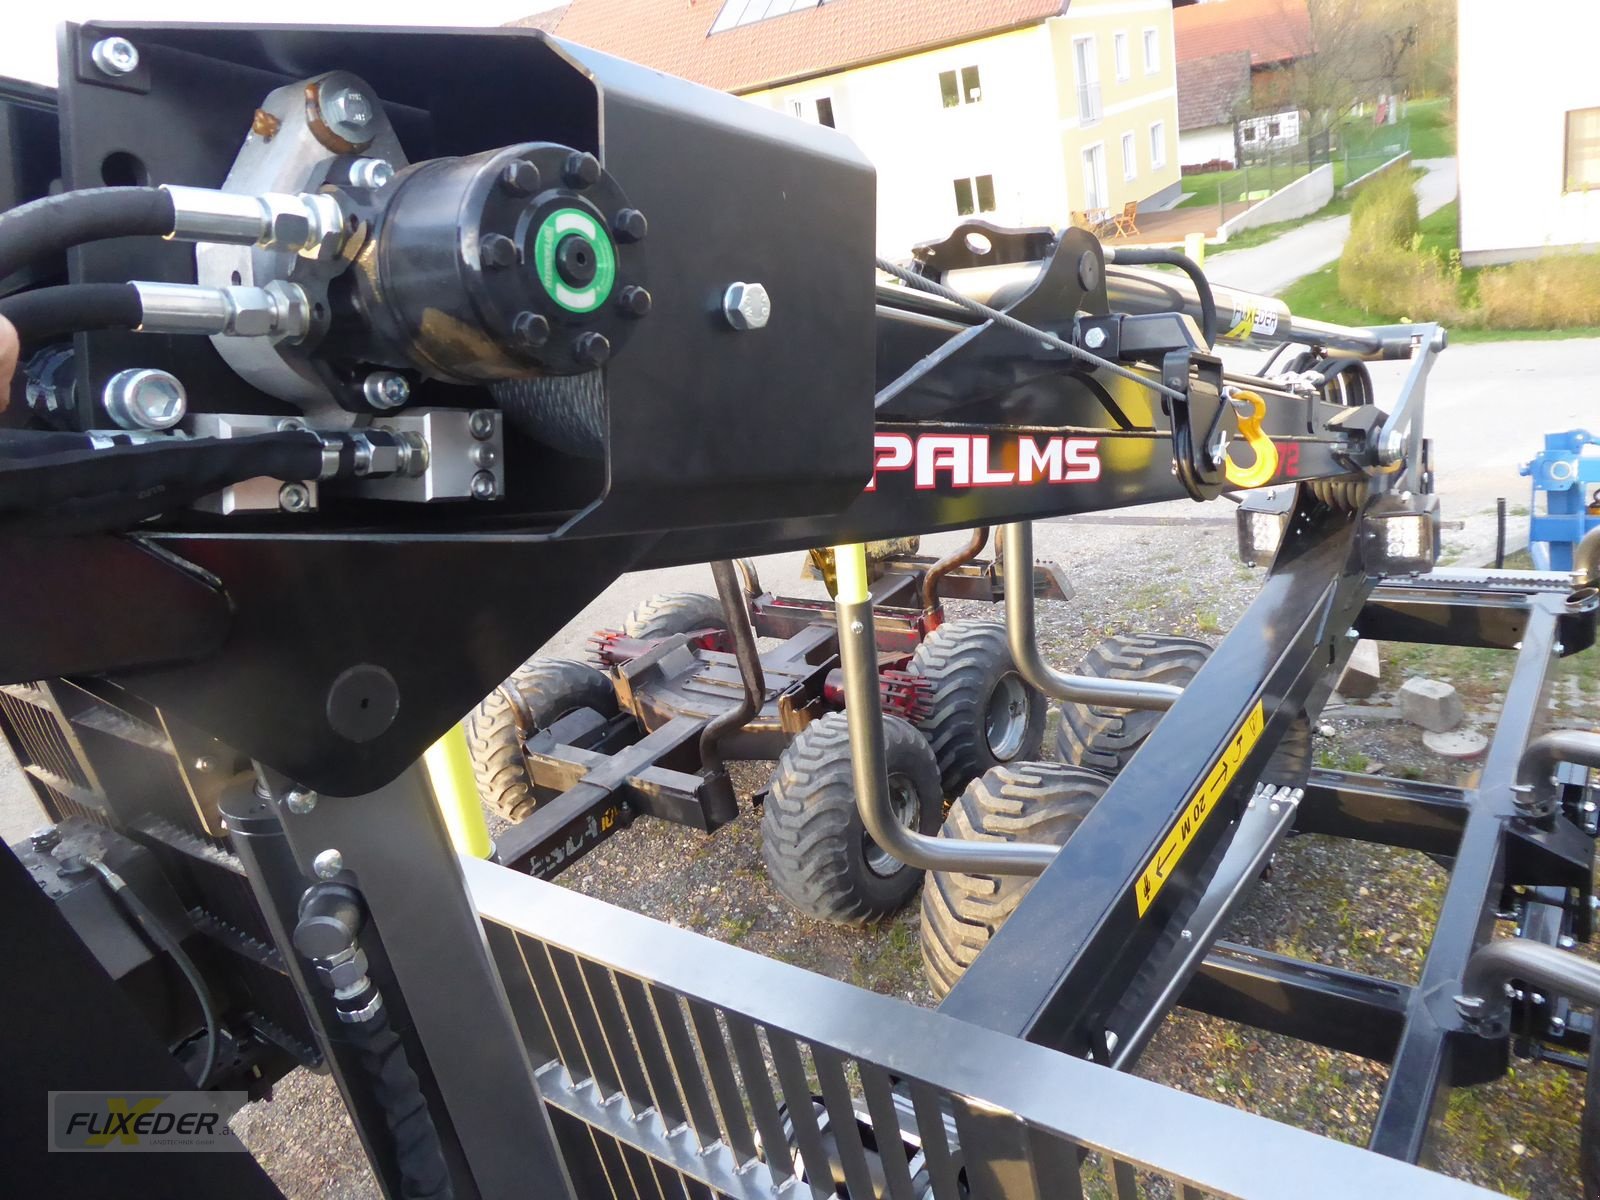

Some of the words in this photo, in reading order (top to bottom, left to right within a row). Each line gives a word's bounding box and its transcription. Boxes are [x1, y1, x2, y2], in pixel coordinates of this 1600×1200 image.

[864, 432, 1101, 492] PALMS
[1193, 793, 1206, 822] 20
[1181, 816, 1191, 842] M
